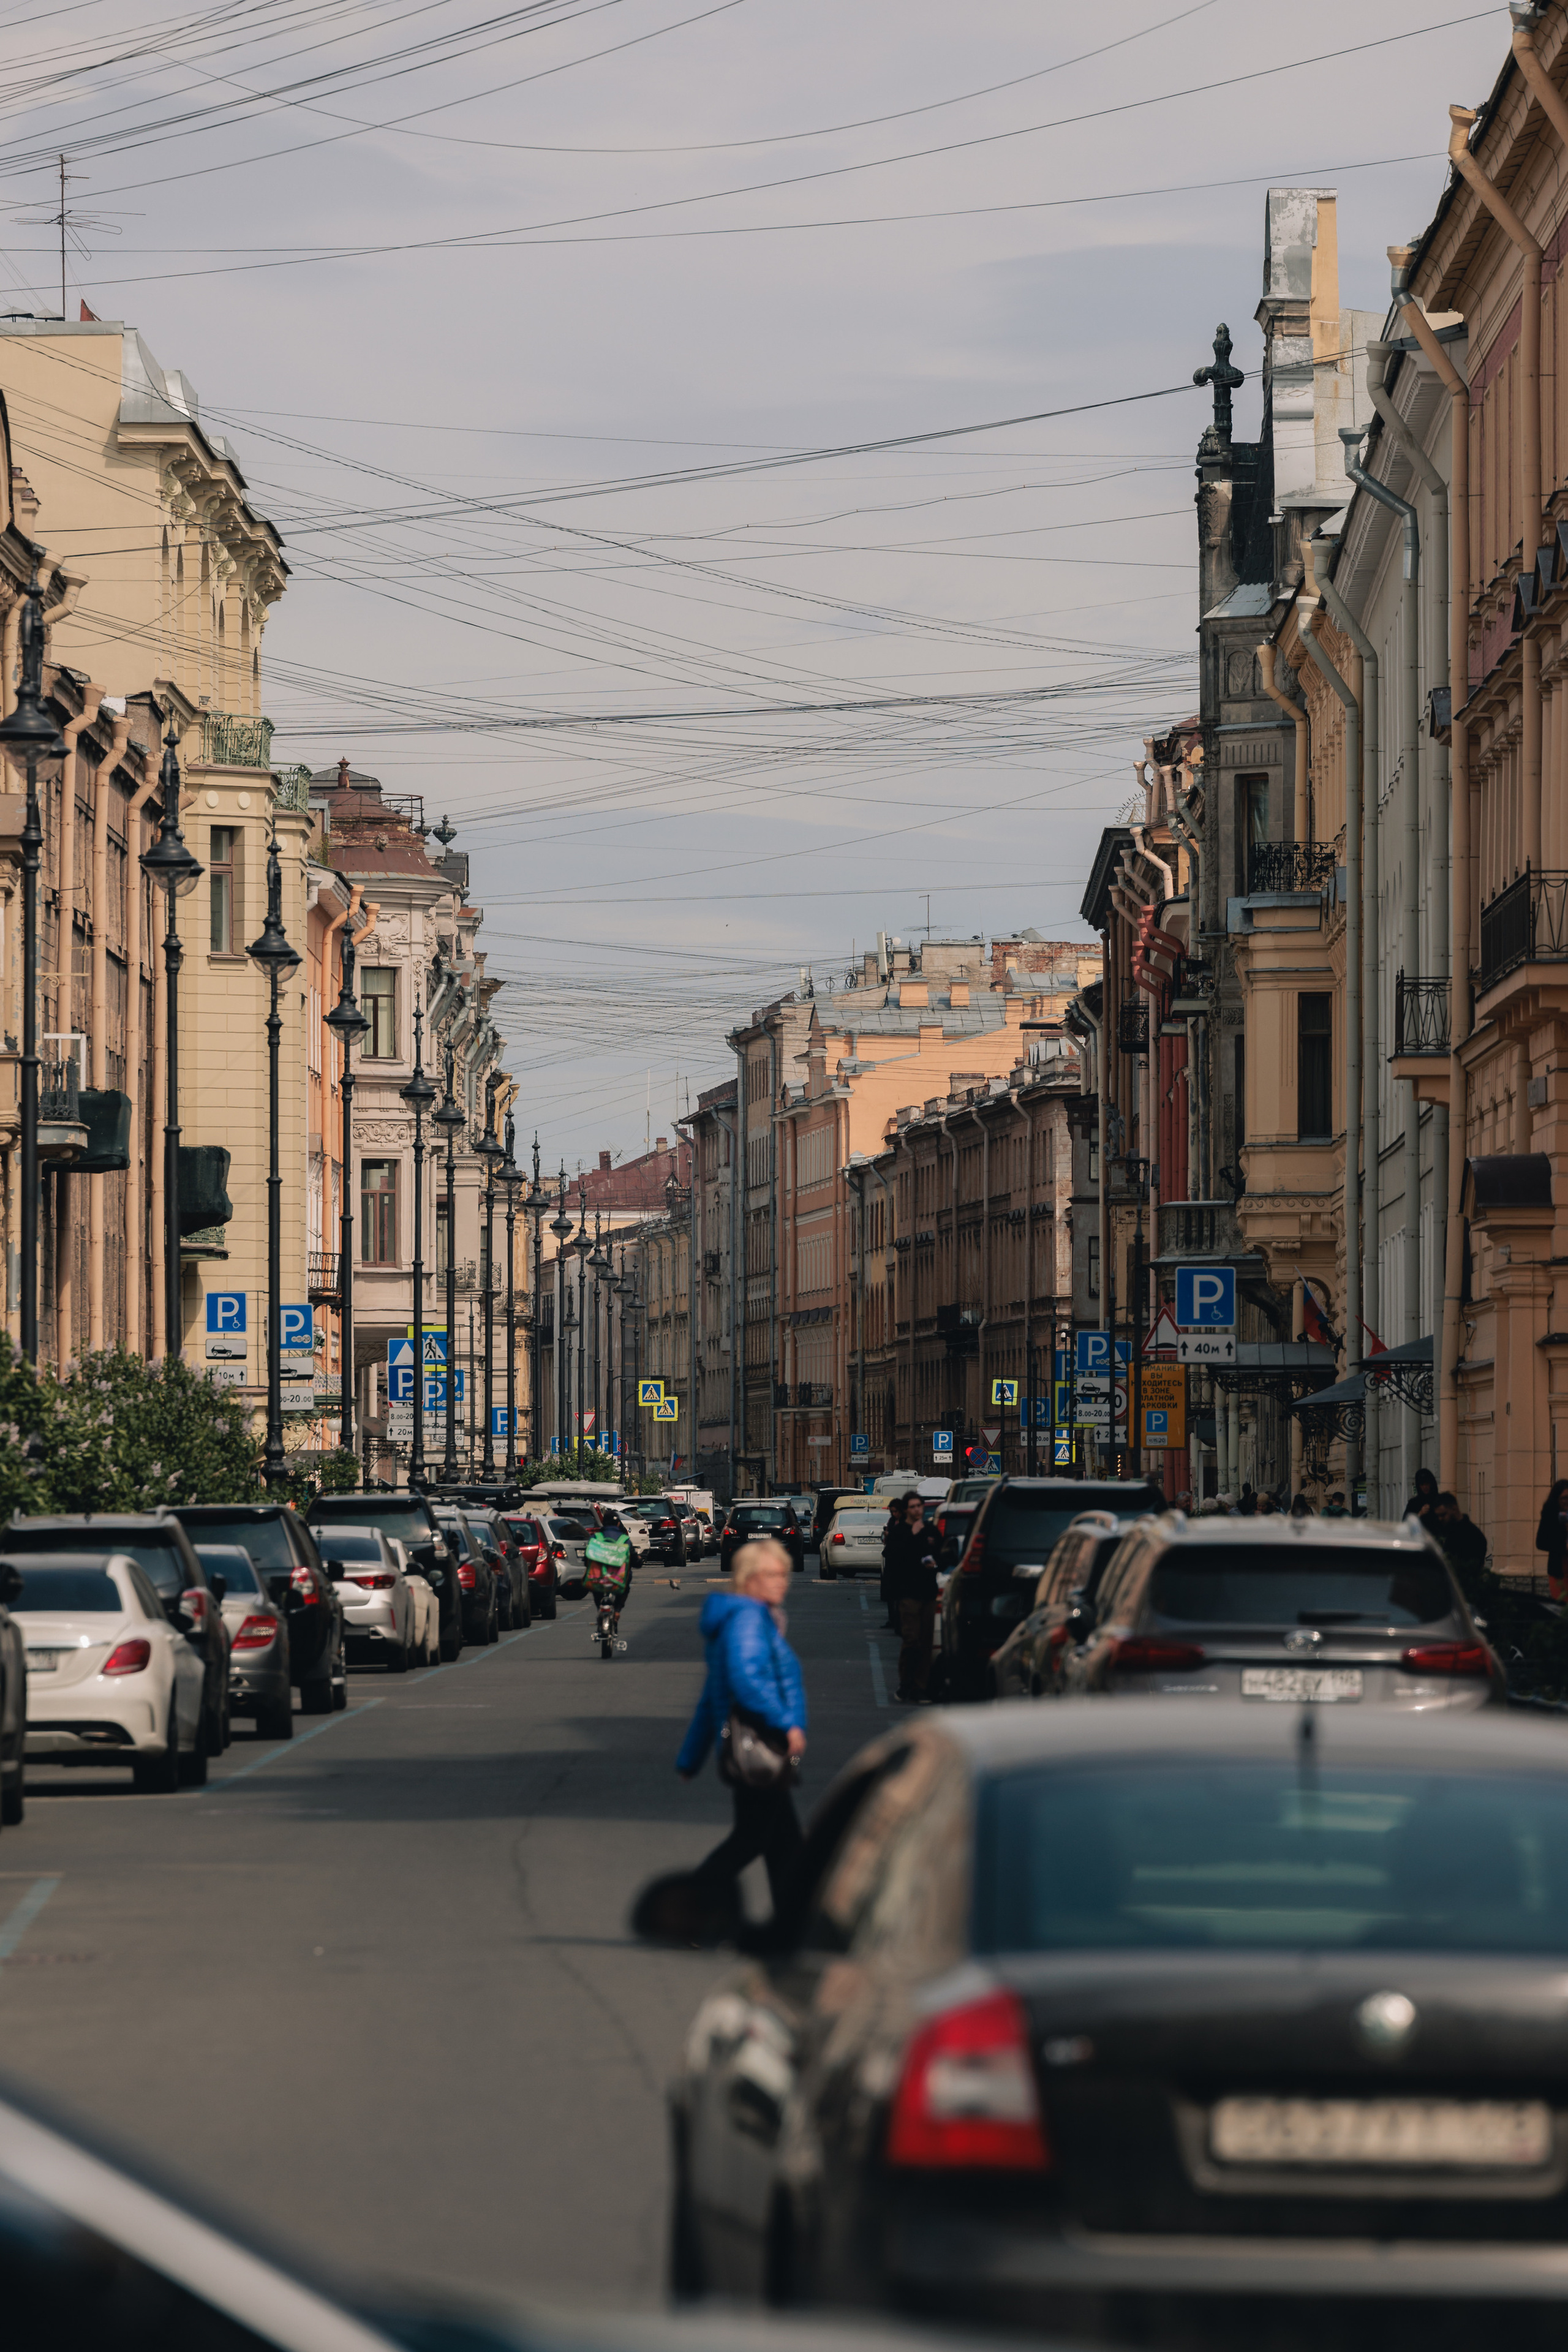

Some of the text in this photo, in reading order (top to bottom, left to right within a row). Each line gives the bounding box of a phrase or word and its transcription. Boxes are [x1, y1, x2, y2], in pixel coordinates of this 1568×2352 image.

[1193, 1275, 1224, 1319] P
[217, 1297, 239, 1328] P
[280, 1310, 305, 1344] P
[1088, 1336, 1107, 1366] P
[399, 1369, 414, 1397] P
[424, 1381, 443, 1408] P
[1152, 1413, 1164, 1430] P
[856, 1437, 865, 1450] P
[939, 1434, 949, 1448] P
